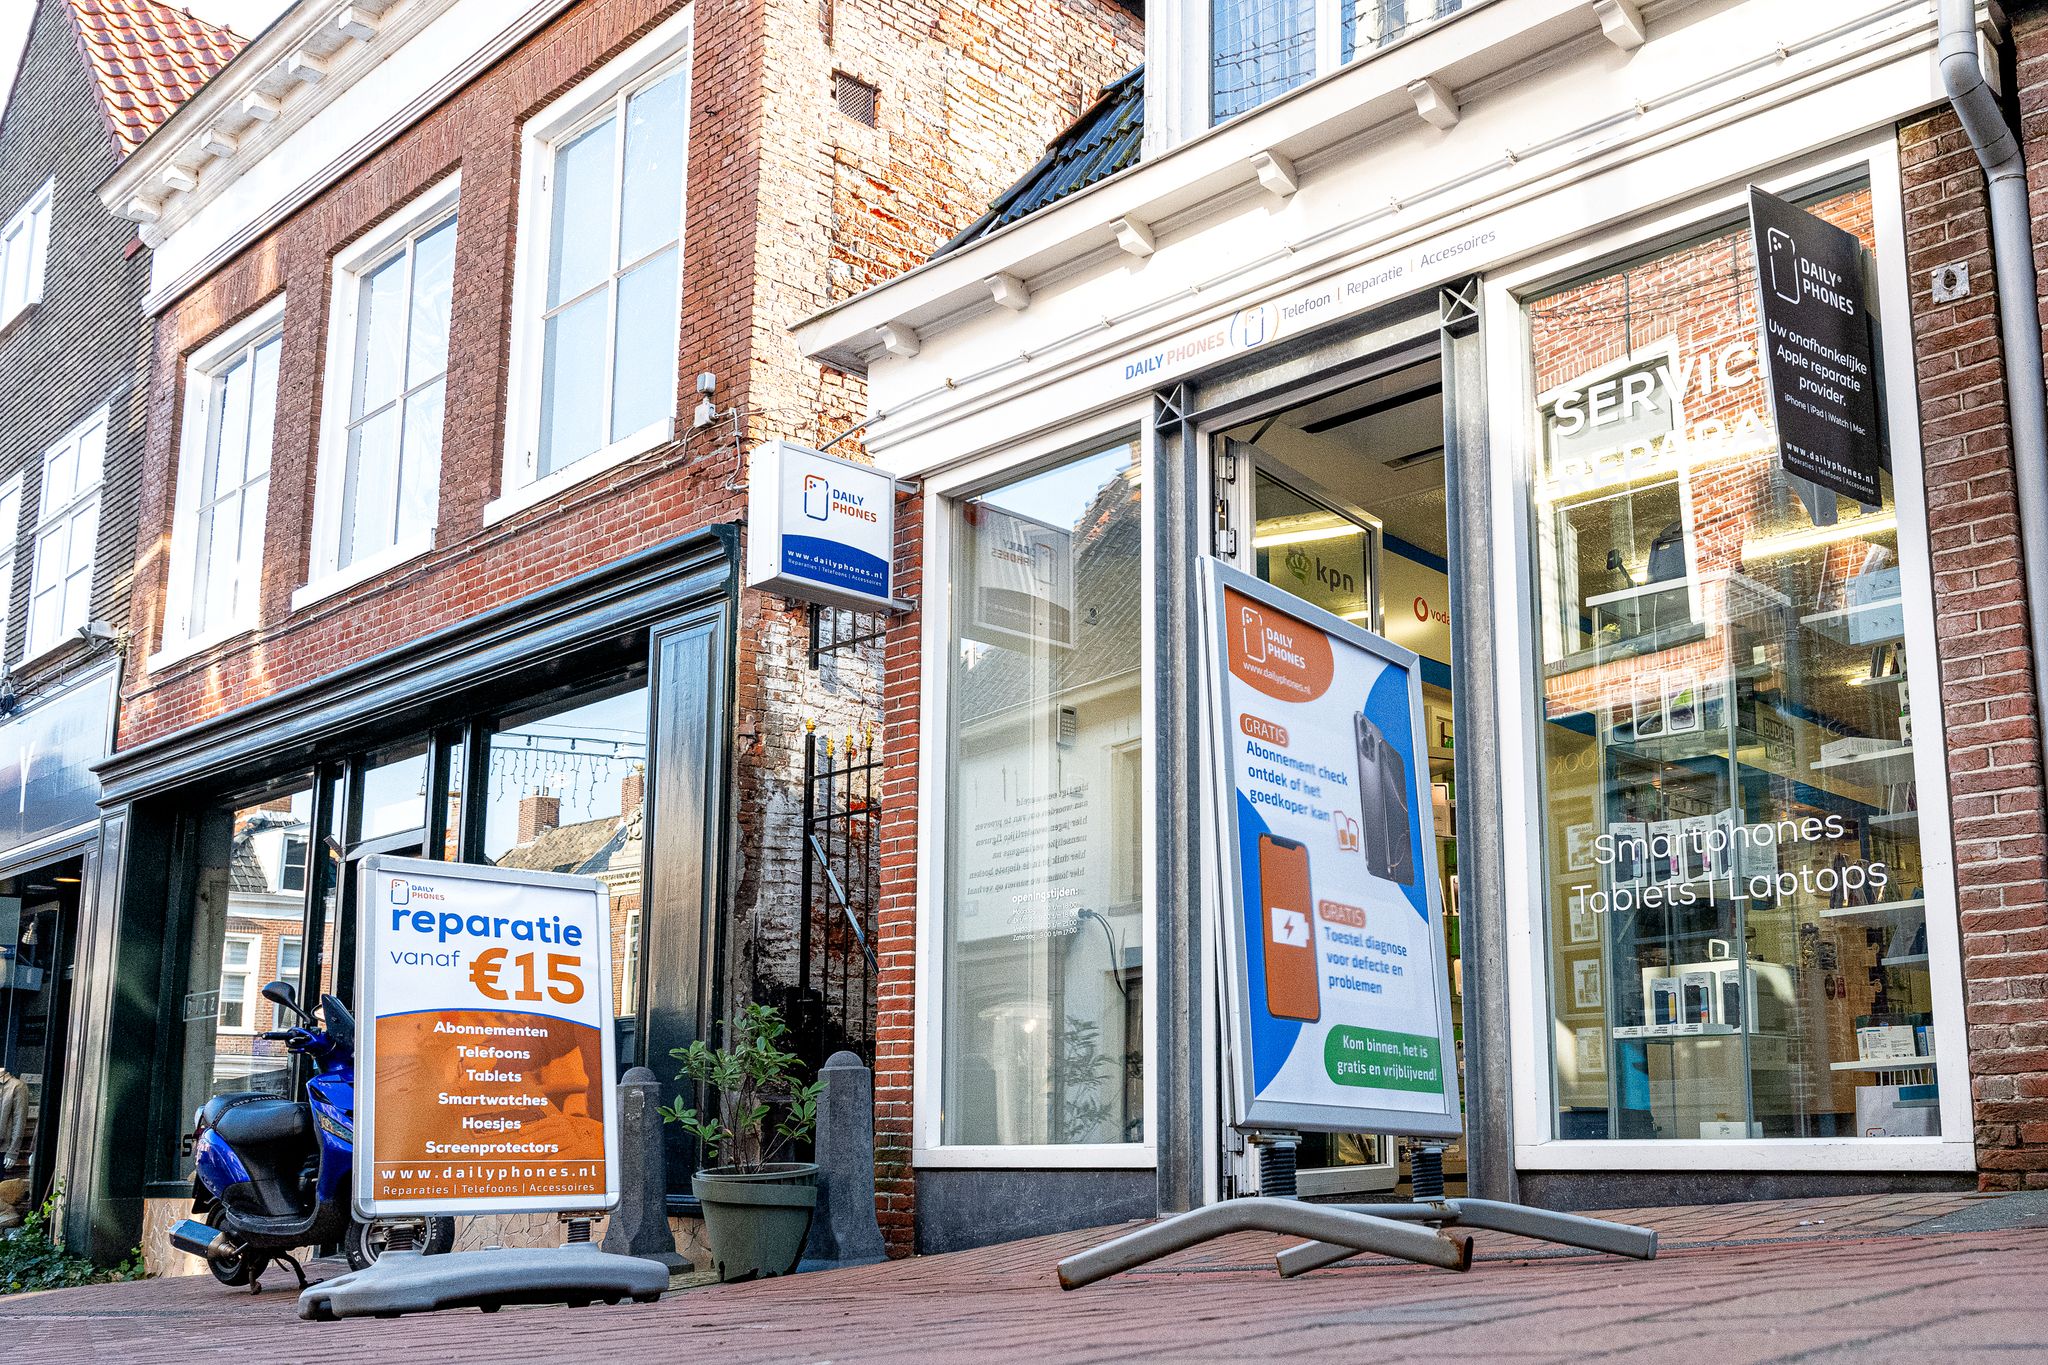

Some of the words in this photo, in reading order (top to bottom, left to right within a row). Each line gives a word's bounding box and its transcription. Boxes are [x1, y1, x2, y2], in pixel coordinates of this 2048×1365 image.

[1282, 294, 1330, 320] Telefoon
[1347, 266, 1403, 296] Reparatie
[1421, 230, 1495, 268] Accessoires
[1803, 278, 1854, 315] PHONES
[1126, 354, 1163, 380] DAILY
[1167, 332, 1224, 365] PHONES
[1769, 319, 1787, 338] Uw
[1789, 331, 1867, 375] onafhankelijke
[1777, 345, 1809, 368] Apple
[1811, 361, 1860, 392] reparatie
[1554, 341, 1758, 436] SERVIC
[1800, 376, 1846, 406] provider.
[1785, 393, 1806, 410] iPhone
[1810, 405, 1824, 418] iPad
[1853, 424, 1865, 435] Mac
[1786, 442, 1874, 485] www.dailyphones.nl
[833, 489, 864, 505] DAILY
[833, 502, 877, 522] PHONES
[787, 550, 883, 579] www.dailyphones.nl
[1316, 558, 1353, 593] kpn
[1430, 609, 1450, 625] voda
[1266, 628, 1293, 649] DAILY
[1268, 645, 1306, 669] PHONES
[1245, 718, 1287, 745] GRATIS
[1246, 741, 1316, 775] Abonnement
[1319, 766, 1348, 785] check
[1248, 767, 1288, 787] ontdek
[1291, 778, 1301, 793] of
[1250, 788, 1308, 816] goedkoper
[1594, 814, 1843, 865] Smartphones
[412, 884, 434, 893] DAILY
[412, 892, 445, 901] PHONES
[1013, 887, 1079, 903] openingstijden:
[1572, 879, 1696, 914] Tablets
[1729, 861, 1888, 908] Laptops
[391, 908, 583, 946] reparatie
[1325, 927, 1363, 947] Toestel
[1365, 936, 1407, 957] diagnose
[390, 950, 461, 967] vanaf
[469, 947, 585, 1004] €15
[1327, 953, 1349, 966] voor
[1352, 958, 1389, 974] defecte
[1392, 965, 1403, 977] en
[1329, 975, 1382, 994] problemen
[434, 1021, 548, 1038] Abonnementen
[457, 1045, 530, 1060] Telefoons
[1343, 1035, 1364, 1051] Kom
[1403, 1042, 1418, 1057] het
[1419, 1045, 1428, 1058] is
[467, 1069, 522, 1083] Tablets
[1337, 1060, 1366, 1075] gratis
[1369, 1063, 1380, 1075] en
[1383, 1062, 1437, 1082] vrijblijvend!
[438, 1092, 548, 1106] Smartwatches
[462, 1116, 521, 1132] Hoesjes
[426, 1140, 559, 1157] Screenprotectors
[382, 1165, 597, 1182] www.dailyphones.nl
[384, 1184, 449, 1196] Reparaties
[462, 1183, 518, 1194] Telefoons
[529, 1182, 595, 1193] Accessoires
